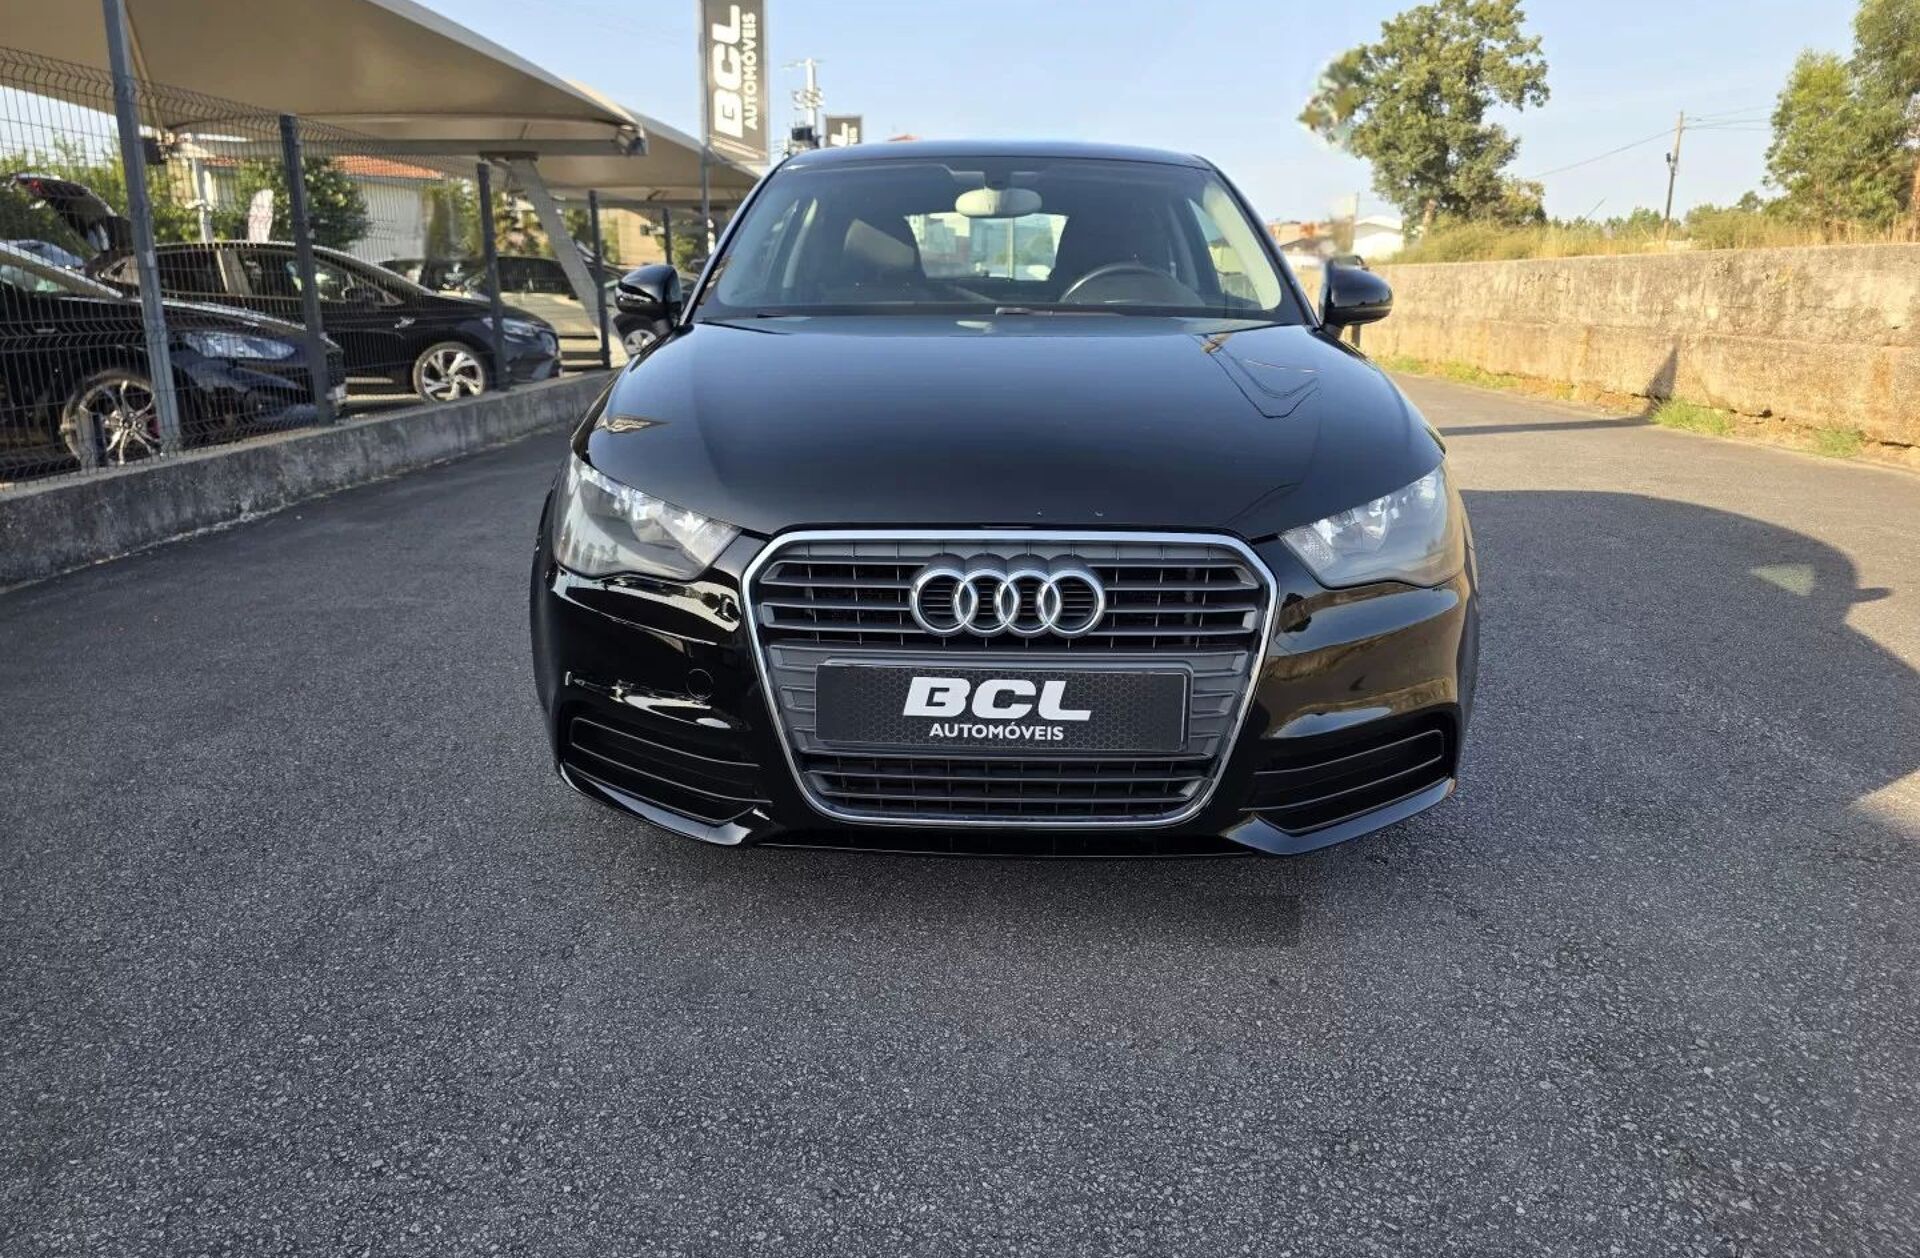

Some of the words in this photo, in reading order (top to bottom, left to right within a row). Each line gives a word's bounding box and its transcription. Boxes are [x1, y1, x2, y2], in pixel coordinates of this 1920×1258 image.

[712, 4, 743, 138] BCL
[742, 12, 758, 131] AUTOMÓVEIS
[903, 676, 1092, 721] BCL
[929, 721, 1064, 741] AUTOMÓVEIS
